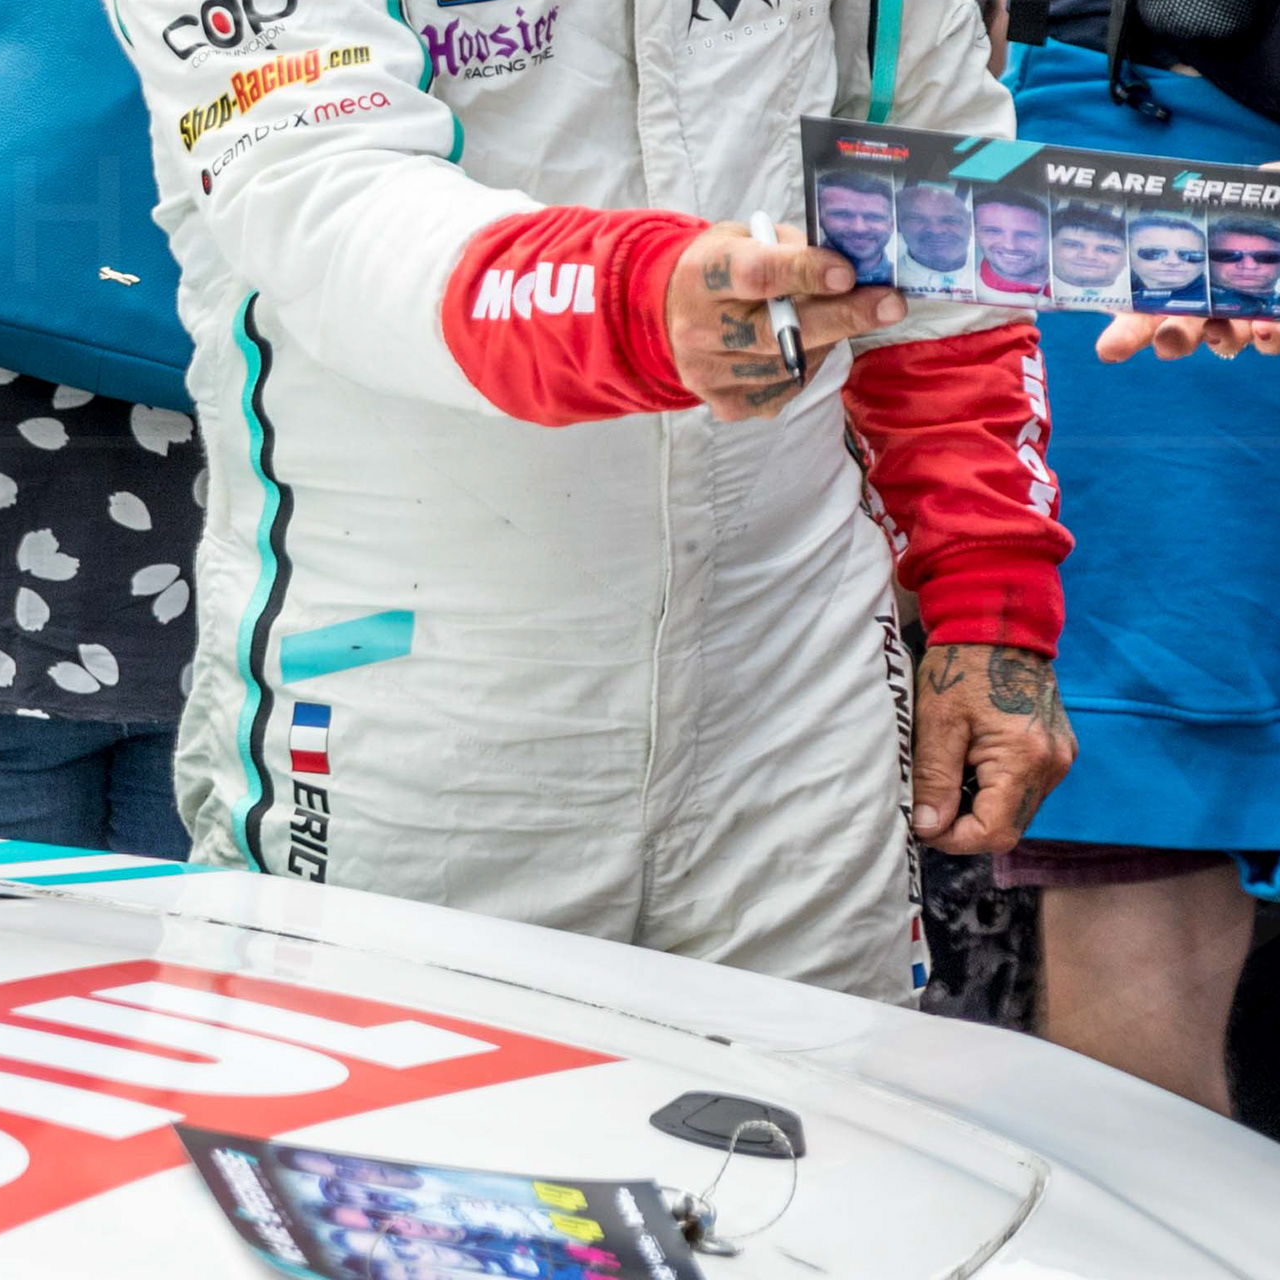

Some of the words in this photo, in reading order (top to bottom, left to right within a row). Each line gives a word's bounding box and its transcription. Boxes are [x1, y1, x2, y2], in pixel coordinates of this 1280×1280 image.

[420, 5, 558, 78] Hoosier
[463, 58, 527, 80] RACING
[1046, 163, 1097, 187] WE
[1101, 171, 1167, 195] ARE
